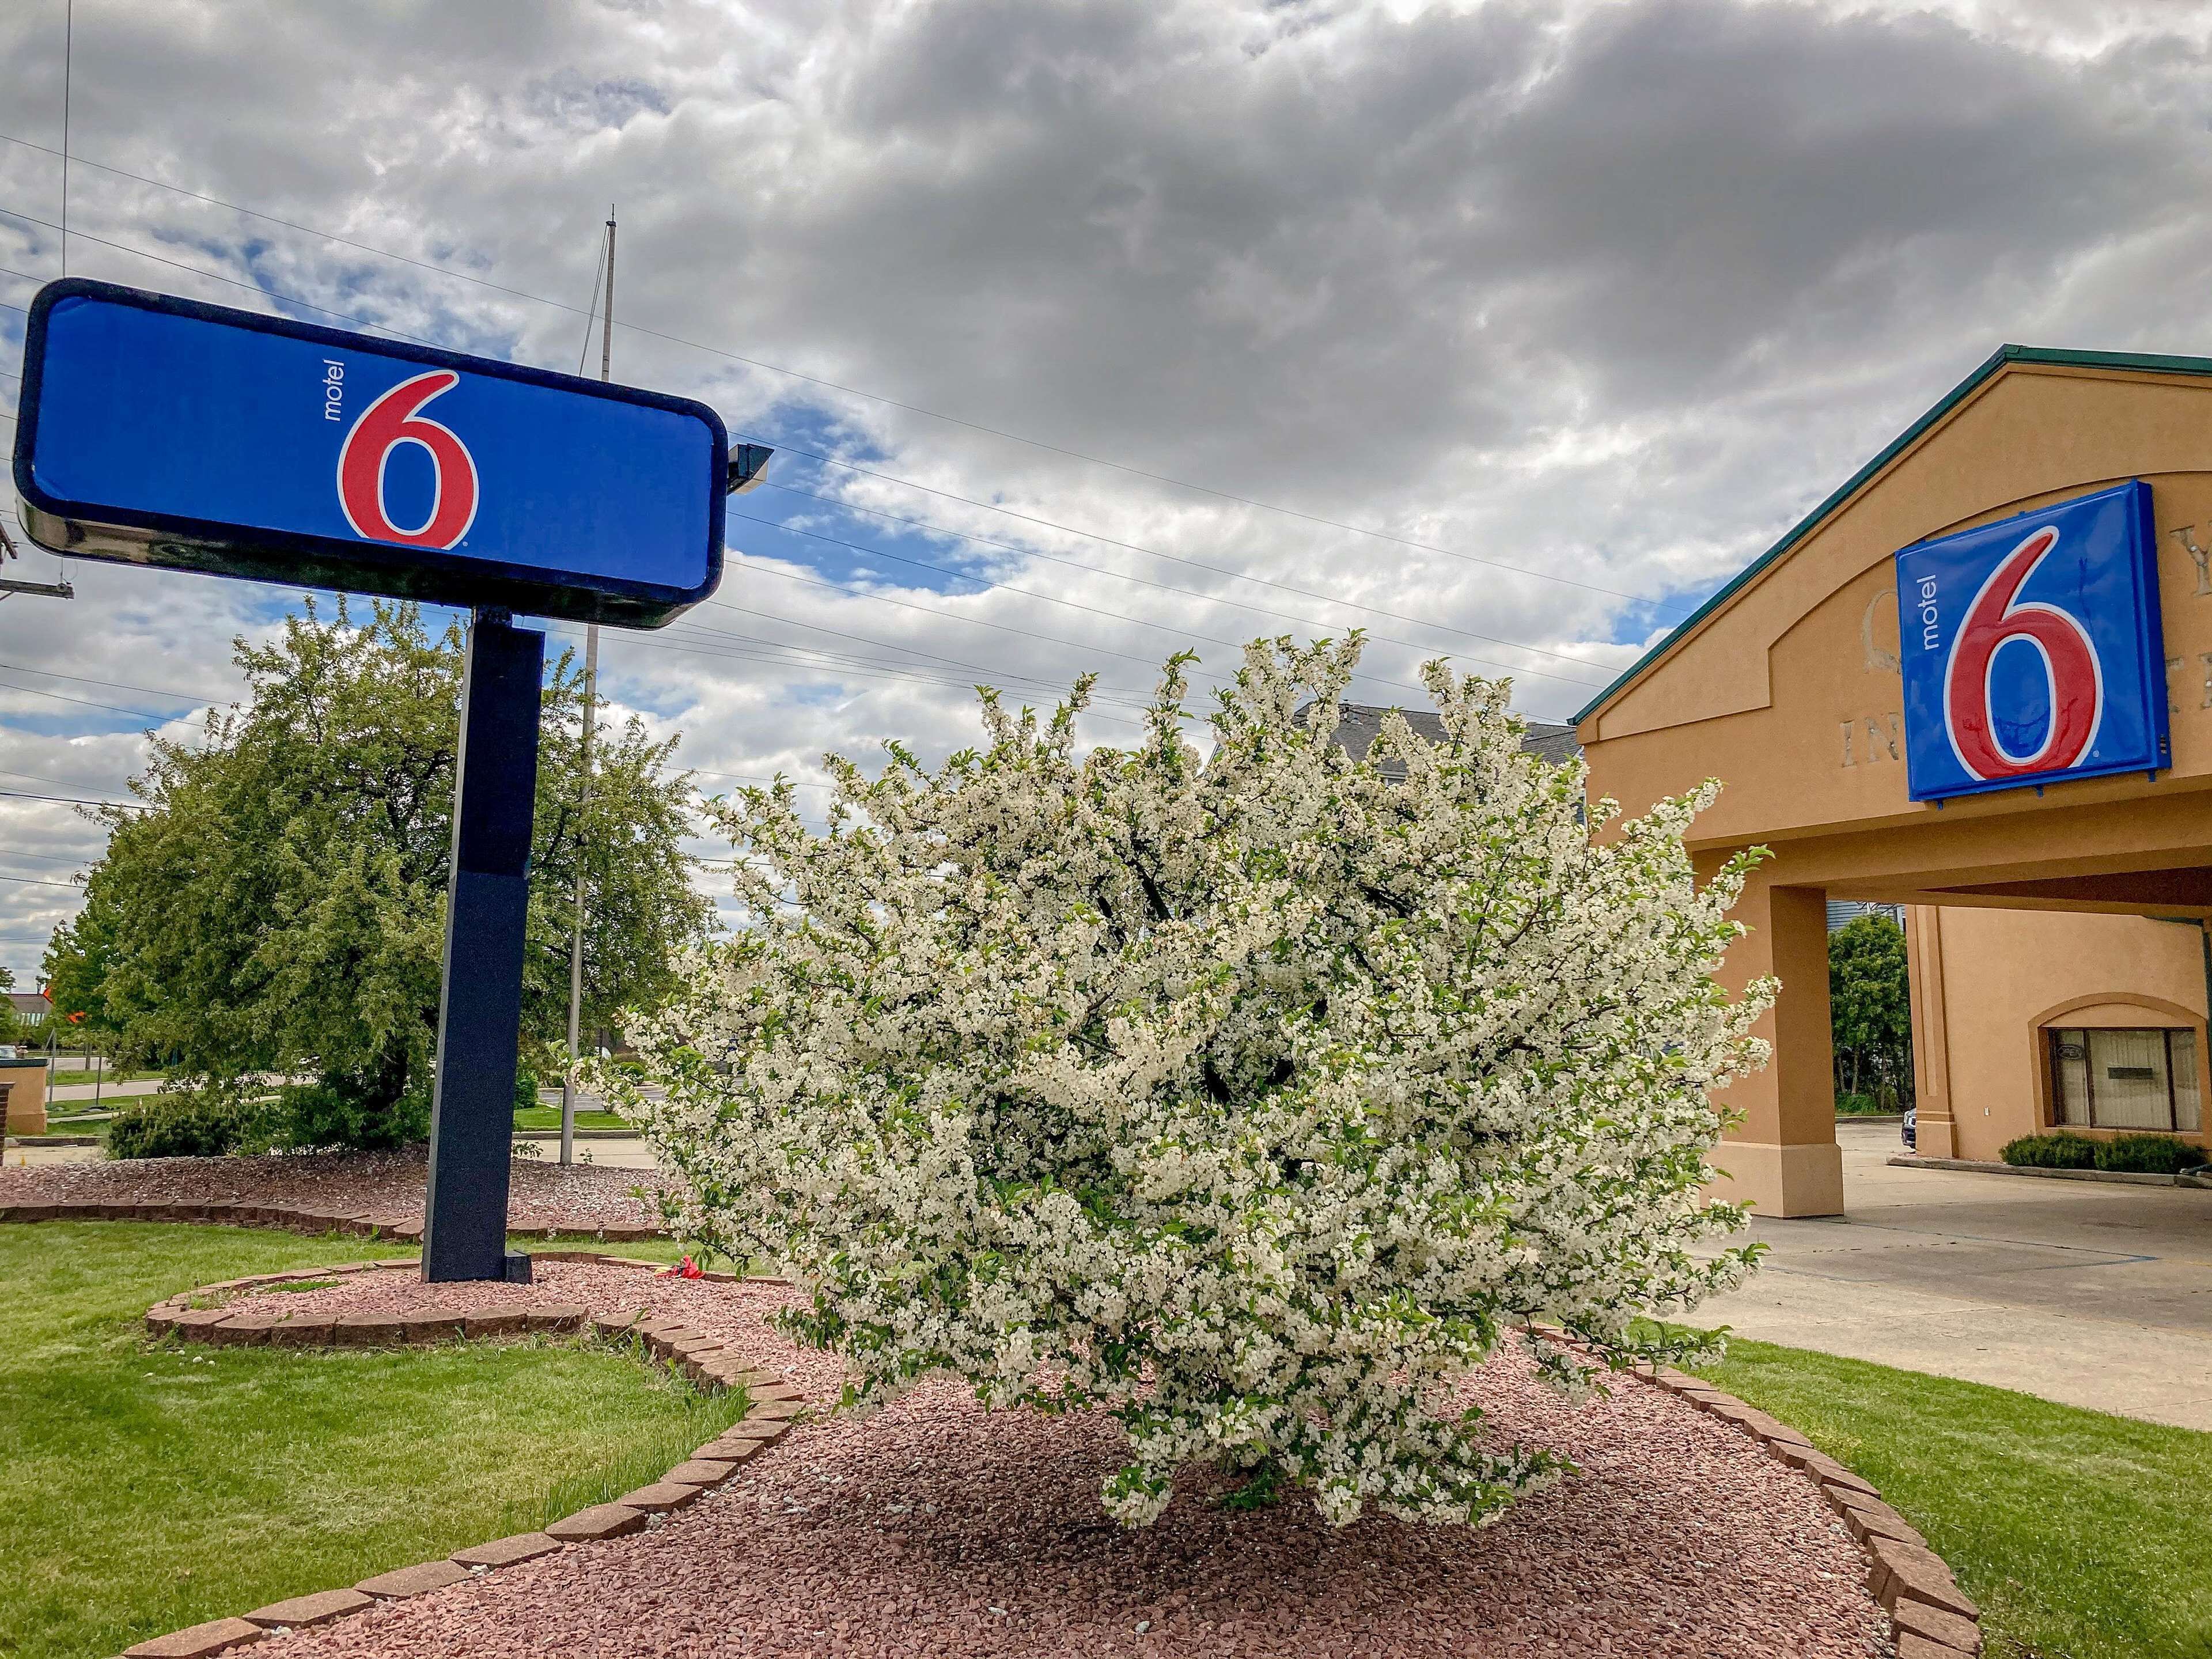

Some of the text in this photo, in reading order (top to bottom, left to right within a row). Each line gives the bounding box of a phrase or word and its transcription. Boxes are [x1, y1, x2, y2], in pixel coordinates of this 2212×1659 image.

[323, 359, 479, 550] motel 6
[1916, 574, 1940, 650] motel
[1943, 525, 2103, 781] 6
